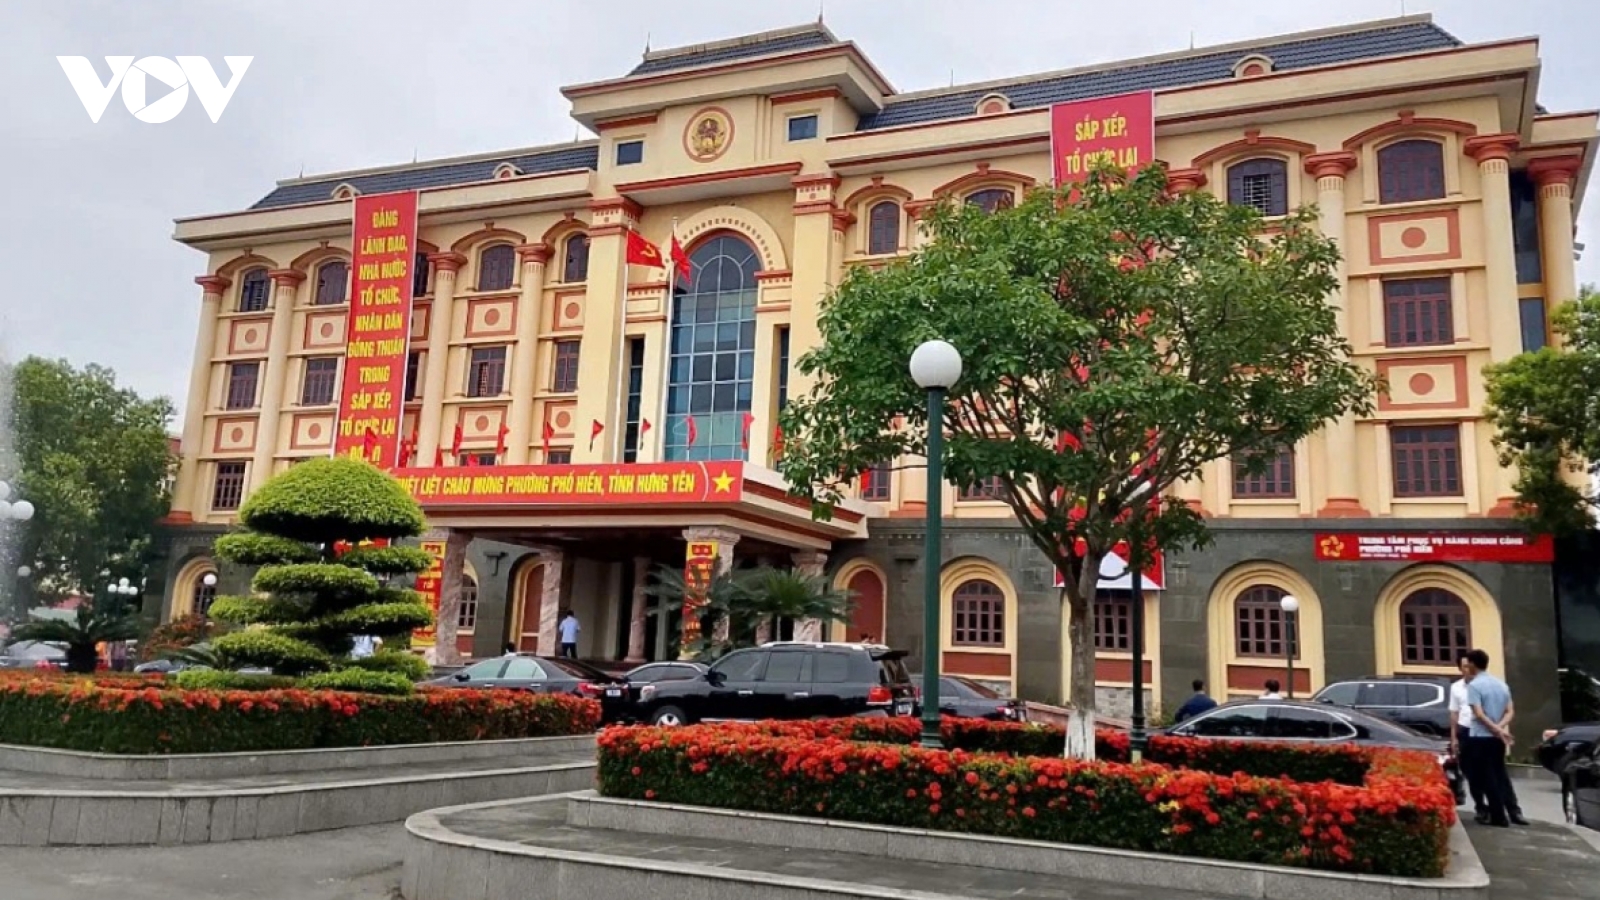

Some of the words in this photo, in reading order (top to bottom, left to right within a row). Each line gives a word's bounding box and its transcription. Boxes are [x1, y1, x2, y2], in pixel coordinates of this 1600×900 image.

[1075, 113, 1100, 142] SẮP
[1102, 111, 1128, 138] XẾP,
[1065, 147, 1081, 175] TỔ
[1119, 146, 1138, 171] LẠI
[372, 206, 399, 229] ĐẢNG
[361, 236, 386, 255] LÃNH
[359, 260, 380, 280] NHÀ
[381, 258, 407, 279] NƯỚC
[361, 283, 374, 306] TỔ
[355, 312, 383, 331] NHÂN
[384, 310, 403, 331] DÂN
[347, 336, 375, 358] ĐỒNG
[377, 335, 405, 359] THUẬN
[359, 365, 391, 384] TRONG
[351, 387, 372, 410] SẮP
[340, 413, 354, 436] TỔ
[382, 418, 396, 438] LẠI
[420, 474, 442, 499] LIỆT
[443, 474, 472, 495] CHÀO
[472, 472, 503, 495] MỪNG
[505, 472, 549, 495] PHƯỜNG
[552, 470, 575, 494] PHỐ
[575, 470, 605, 496] HIẾN,
[608, 469, 635, 493] TỈNH
[638, 472, 669, 493] HƯNG
[672, 470, 695, 493] YÊN
